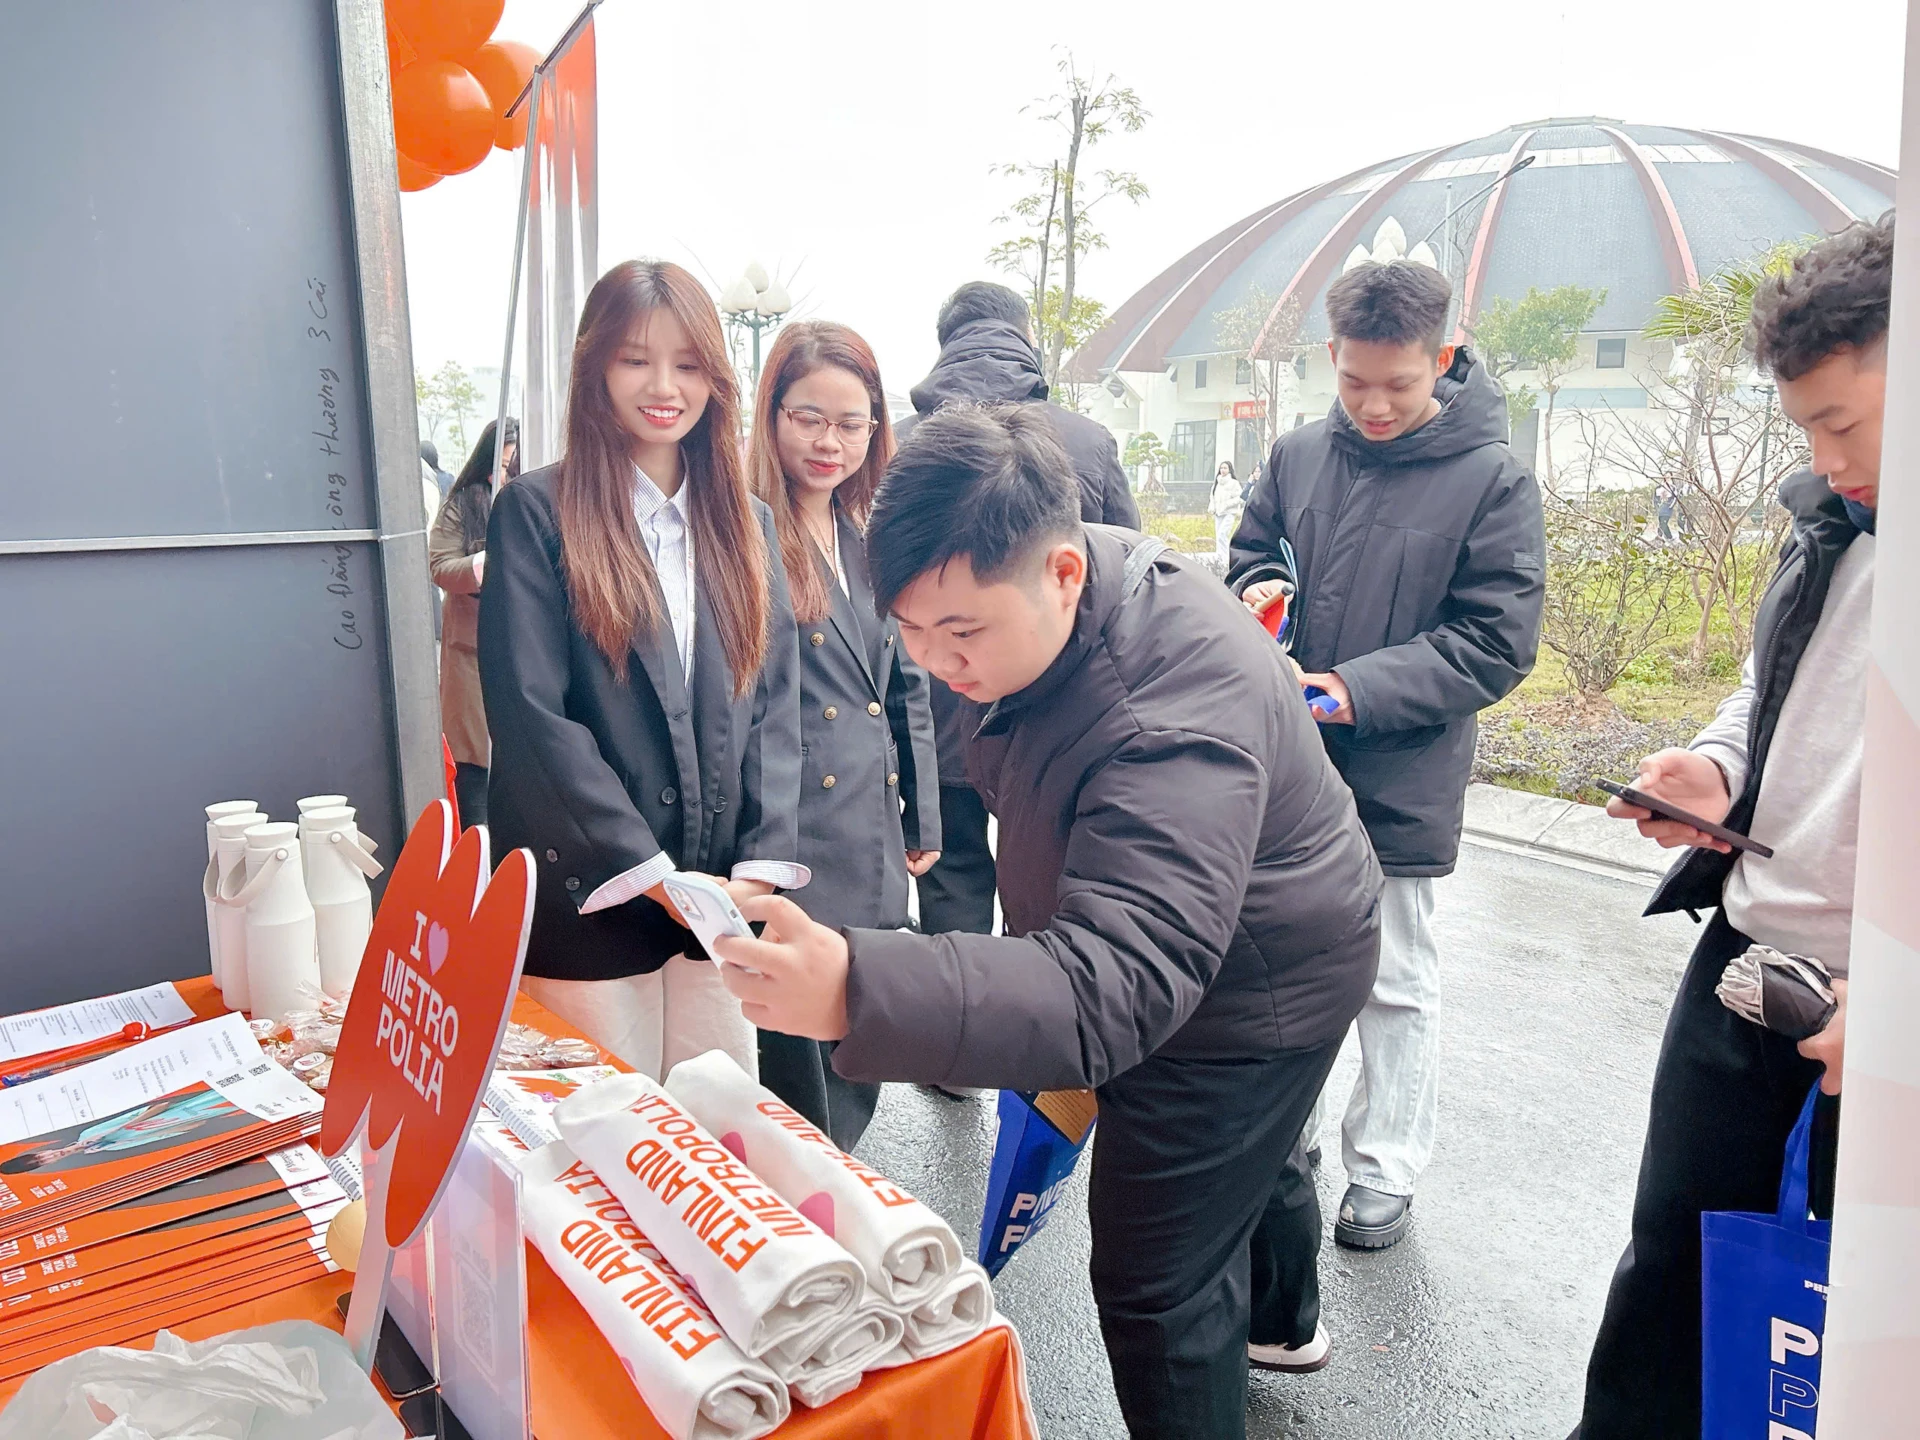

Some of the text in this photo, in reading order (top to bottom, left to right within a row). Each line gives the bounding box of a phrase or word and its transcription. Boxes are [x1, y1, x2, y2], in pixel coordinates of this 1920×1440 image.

[307, 326, 331, 342] 3
[333, 610, 362, 650] Cao
[381, 949, 459, 1057] METRO
[376, 1002, 444, 1116] POLIA
[625, 1139, 768, 1273] FINLAND
[560, 1220, 722, 1361] FINLAND
